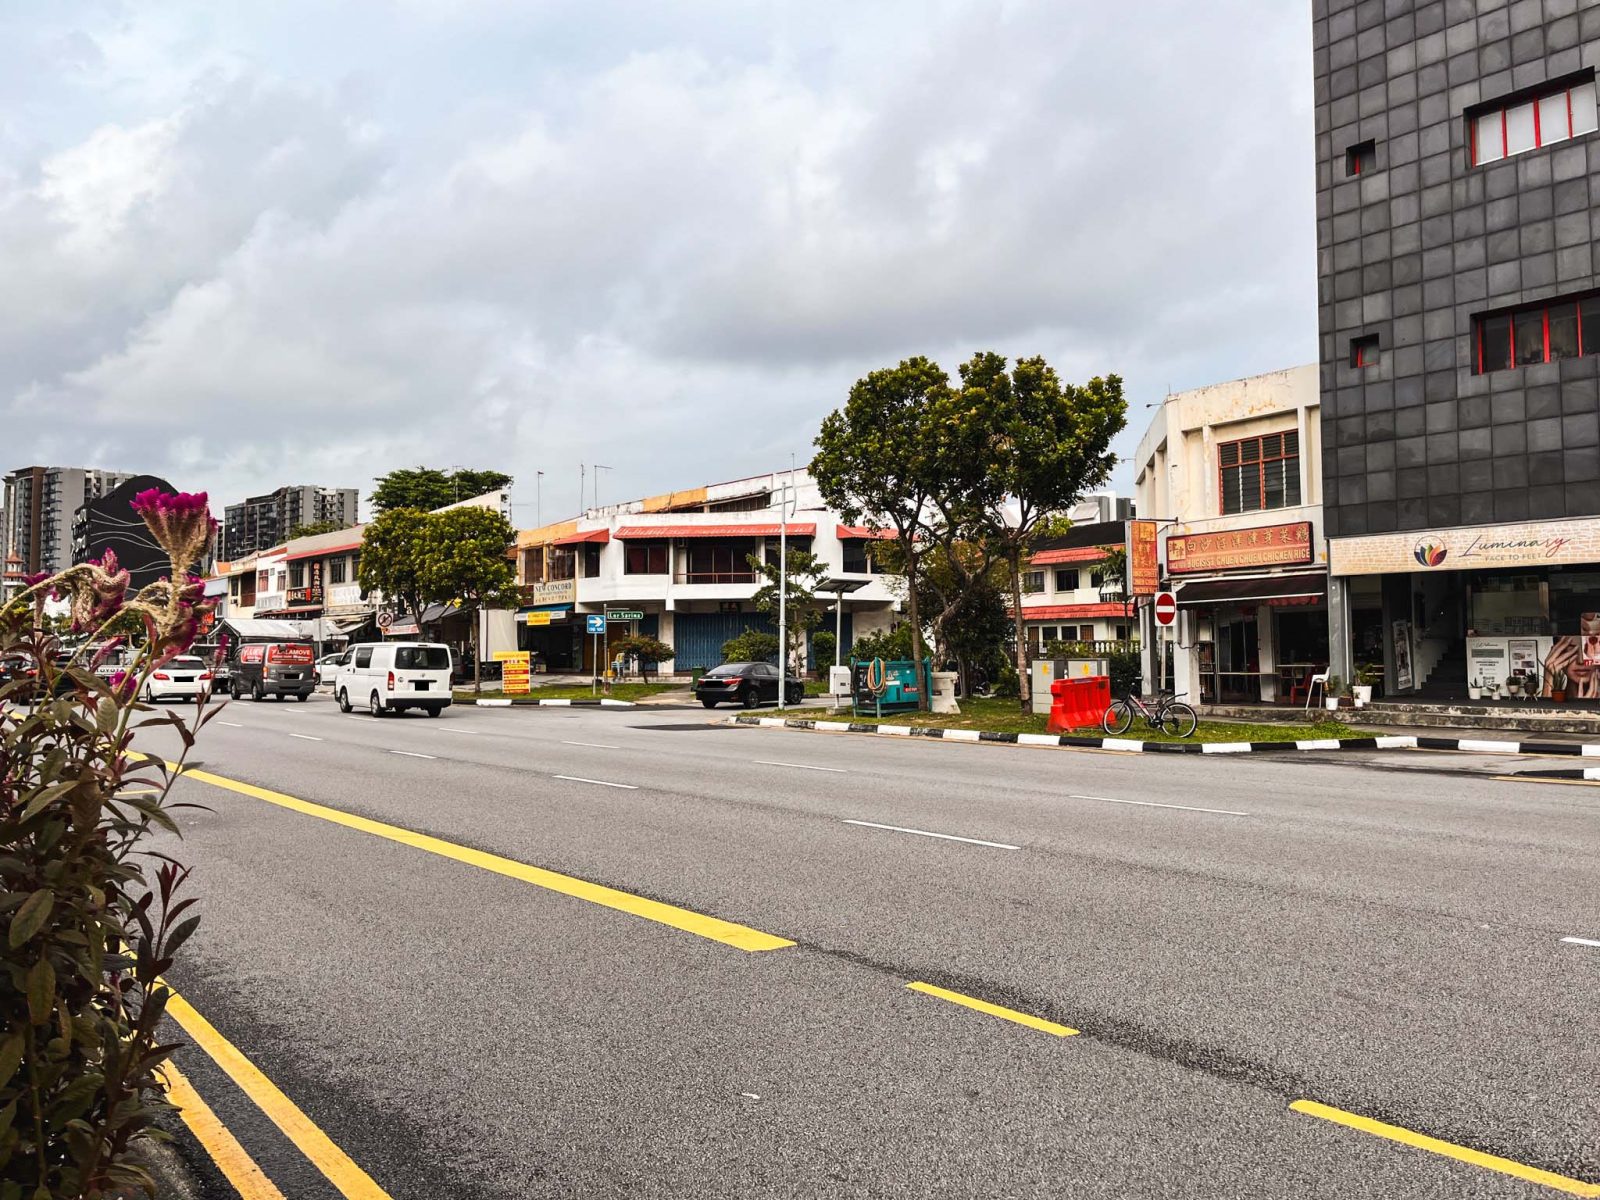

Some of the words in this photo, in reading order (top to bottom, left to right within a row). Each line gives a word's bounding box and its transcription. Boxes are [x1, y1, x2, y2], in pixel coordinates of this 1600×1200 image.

[1263, 550, 1293, 562] CHICKEN
[1293, 548, 1310, 560] RICE
[1458, 534, 1572, 558] Luminary
